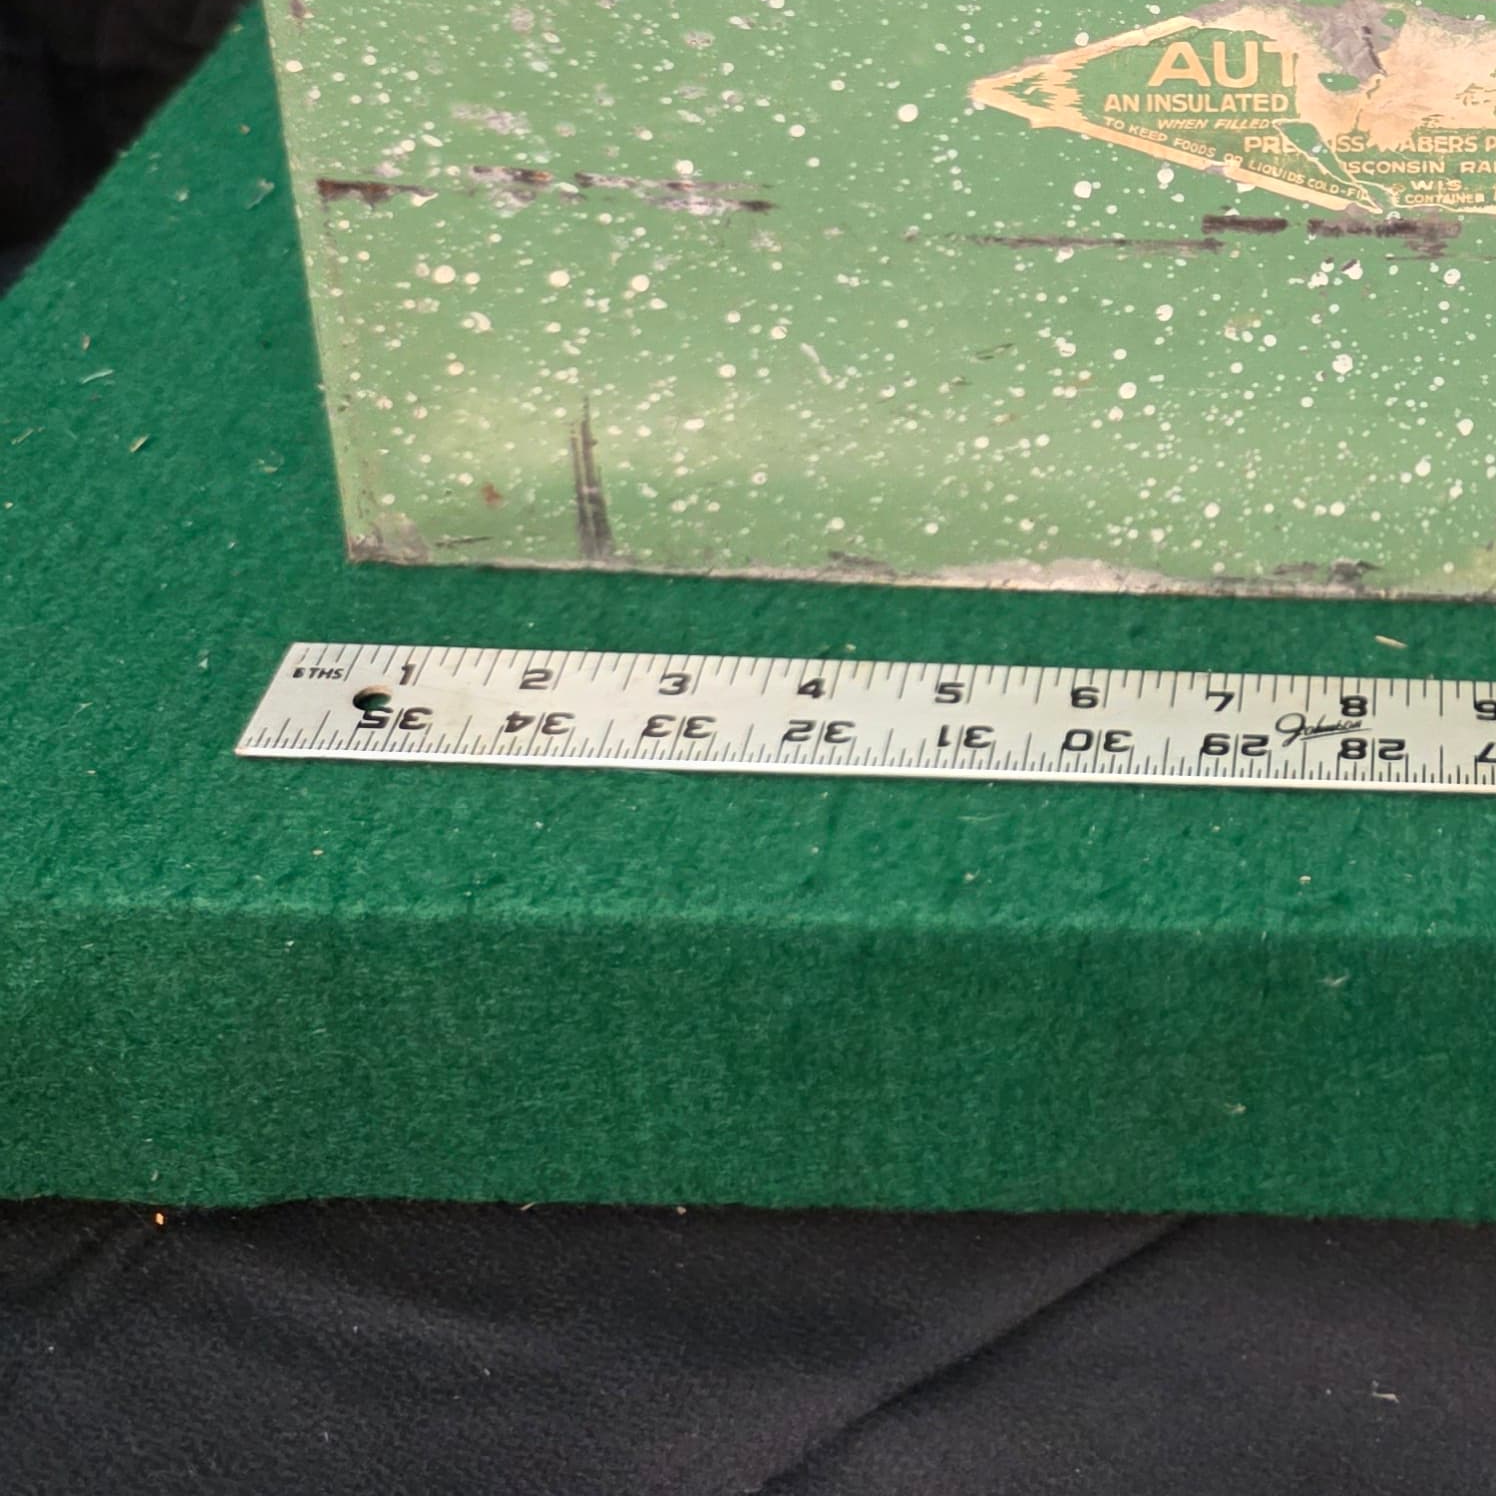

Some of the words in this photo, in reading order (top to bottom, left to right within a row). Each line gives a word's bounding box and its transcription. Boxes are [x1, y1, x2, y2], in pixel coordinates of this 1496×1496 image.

[1147, 40, 1295, 88] AUT
[1103, 93, 1140, 113] AN
[1146, 93, 1289, 113] INSULATED
[1157, 118, 1208, 130] WHEN
[1214, 118, 1270, 130] FILLED
[1103, 116, 1125, 131] TO
[1129, 124, 1168, 142] KEEP
[1173, 136, 1217, 158] FOODS
[1248, 160, 1306, 185] LIQUIDS
[1341, 160, 1446, 175] ISCONSIN
[400, 664, 416, 686] 1
[519, 668, 554, 690] 2
[657, 672, 693, 696] 3
[797, 677, 826, 699] 4
[934, 682, 965, 704] 5
[1071, 686, 1100, 709] 6
[1205, 691, 1235, 713] 7
[1341, 695, 1368, 717] 8
[360, 707, 434, 731] 35
[504, 710, 576, 736] 34
[643, 714, 716, 739] 33
[783, 719, 856, 745] 32
[936, 725, 995, 749] 31
[1062, 729, 1132, 753] 30
[1202, 733, 1270, 757] 29
[1338, 736, 1406, 761] 28
